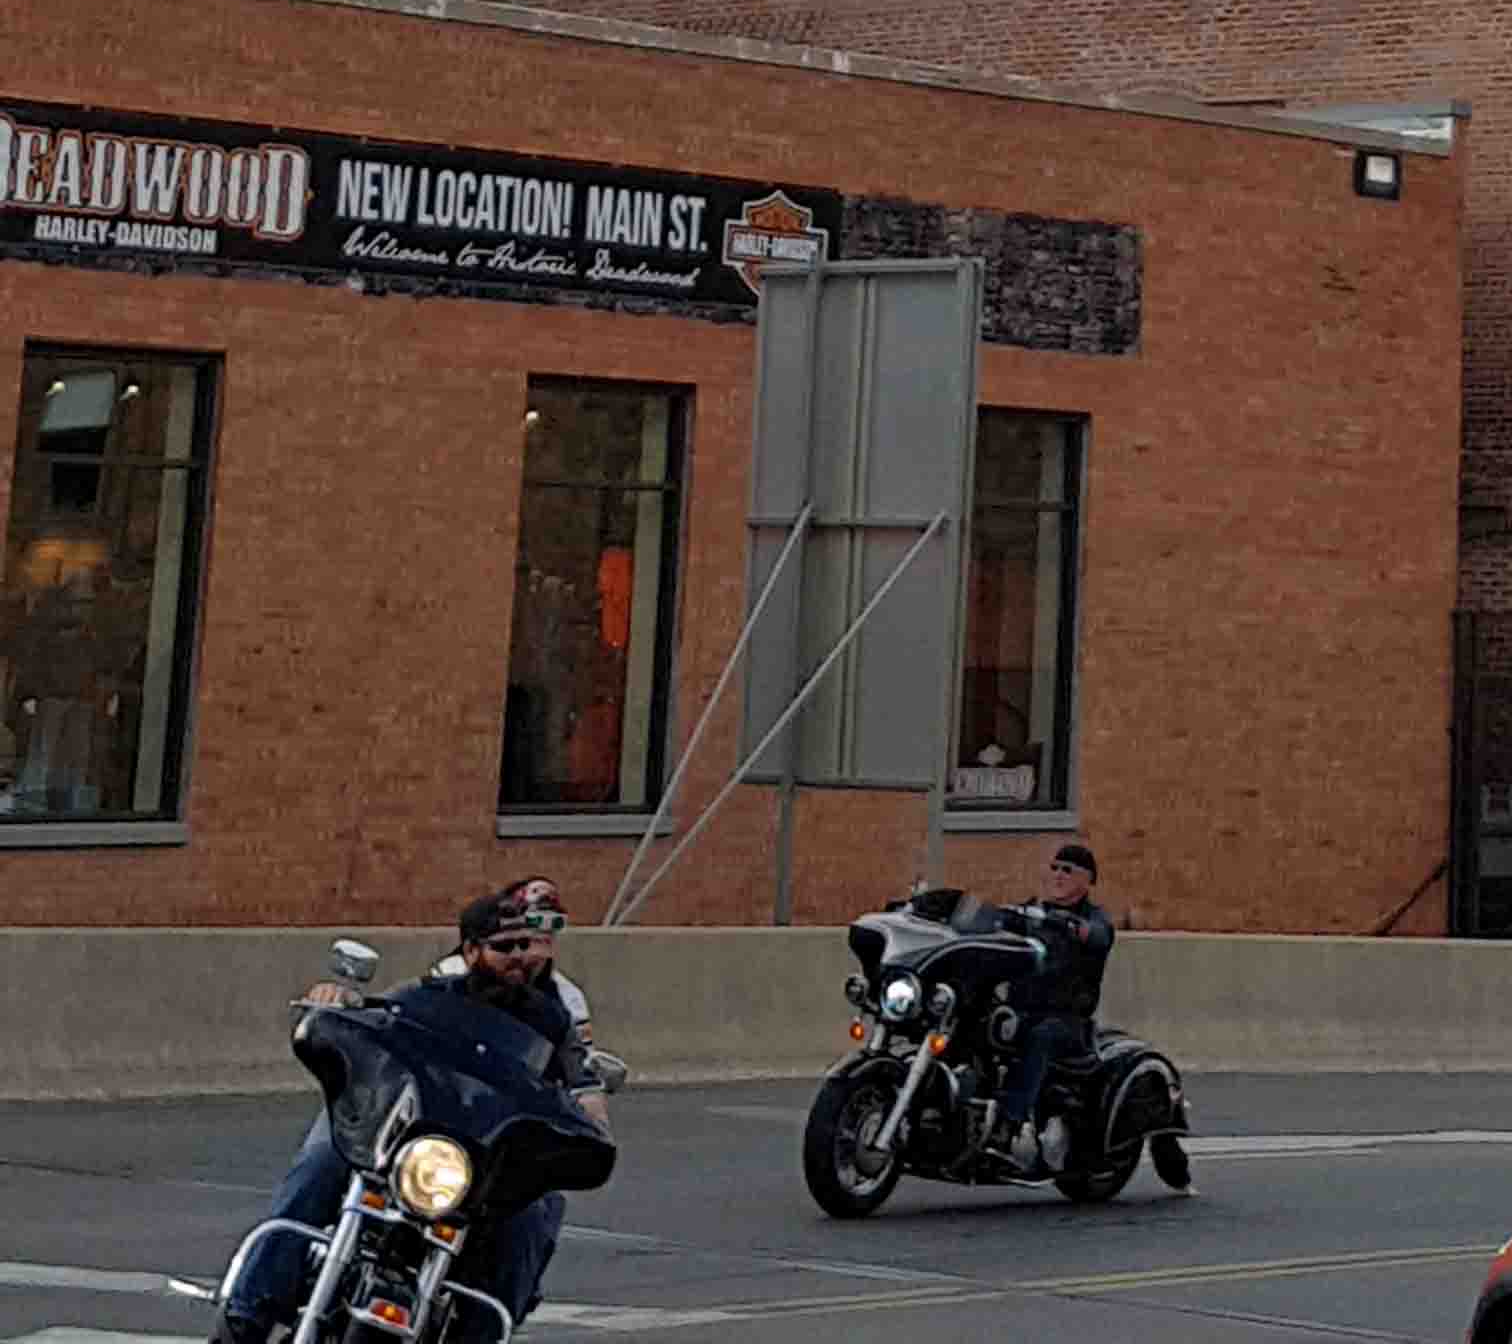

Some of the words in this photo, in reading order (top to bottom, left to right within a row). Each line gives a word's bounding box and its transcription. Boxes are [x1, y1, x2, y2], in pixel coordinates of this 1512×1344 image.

[34, 214, 217, 254] HARLEY-DAVIDSON
[338, 159, 414, 223] NEW
[416, 167, 575, 239] LOCATION!
[585, 185, 664, 248] MAIN
[667, 194, 709, 253] ST.
[342, 225, 449, 266] Welcome
[455, 241, 488, 268] to
[488, 239, 577, 276] Historic
[585, 248, 702, 287] Deadwood
